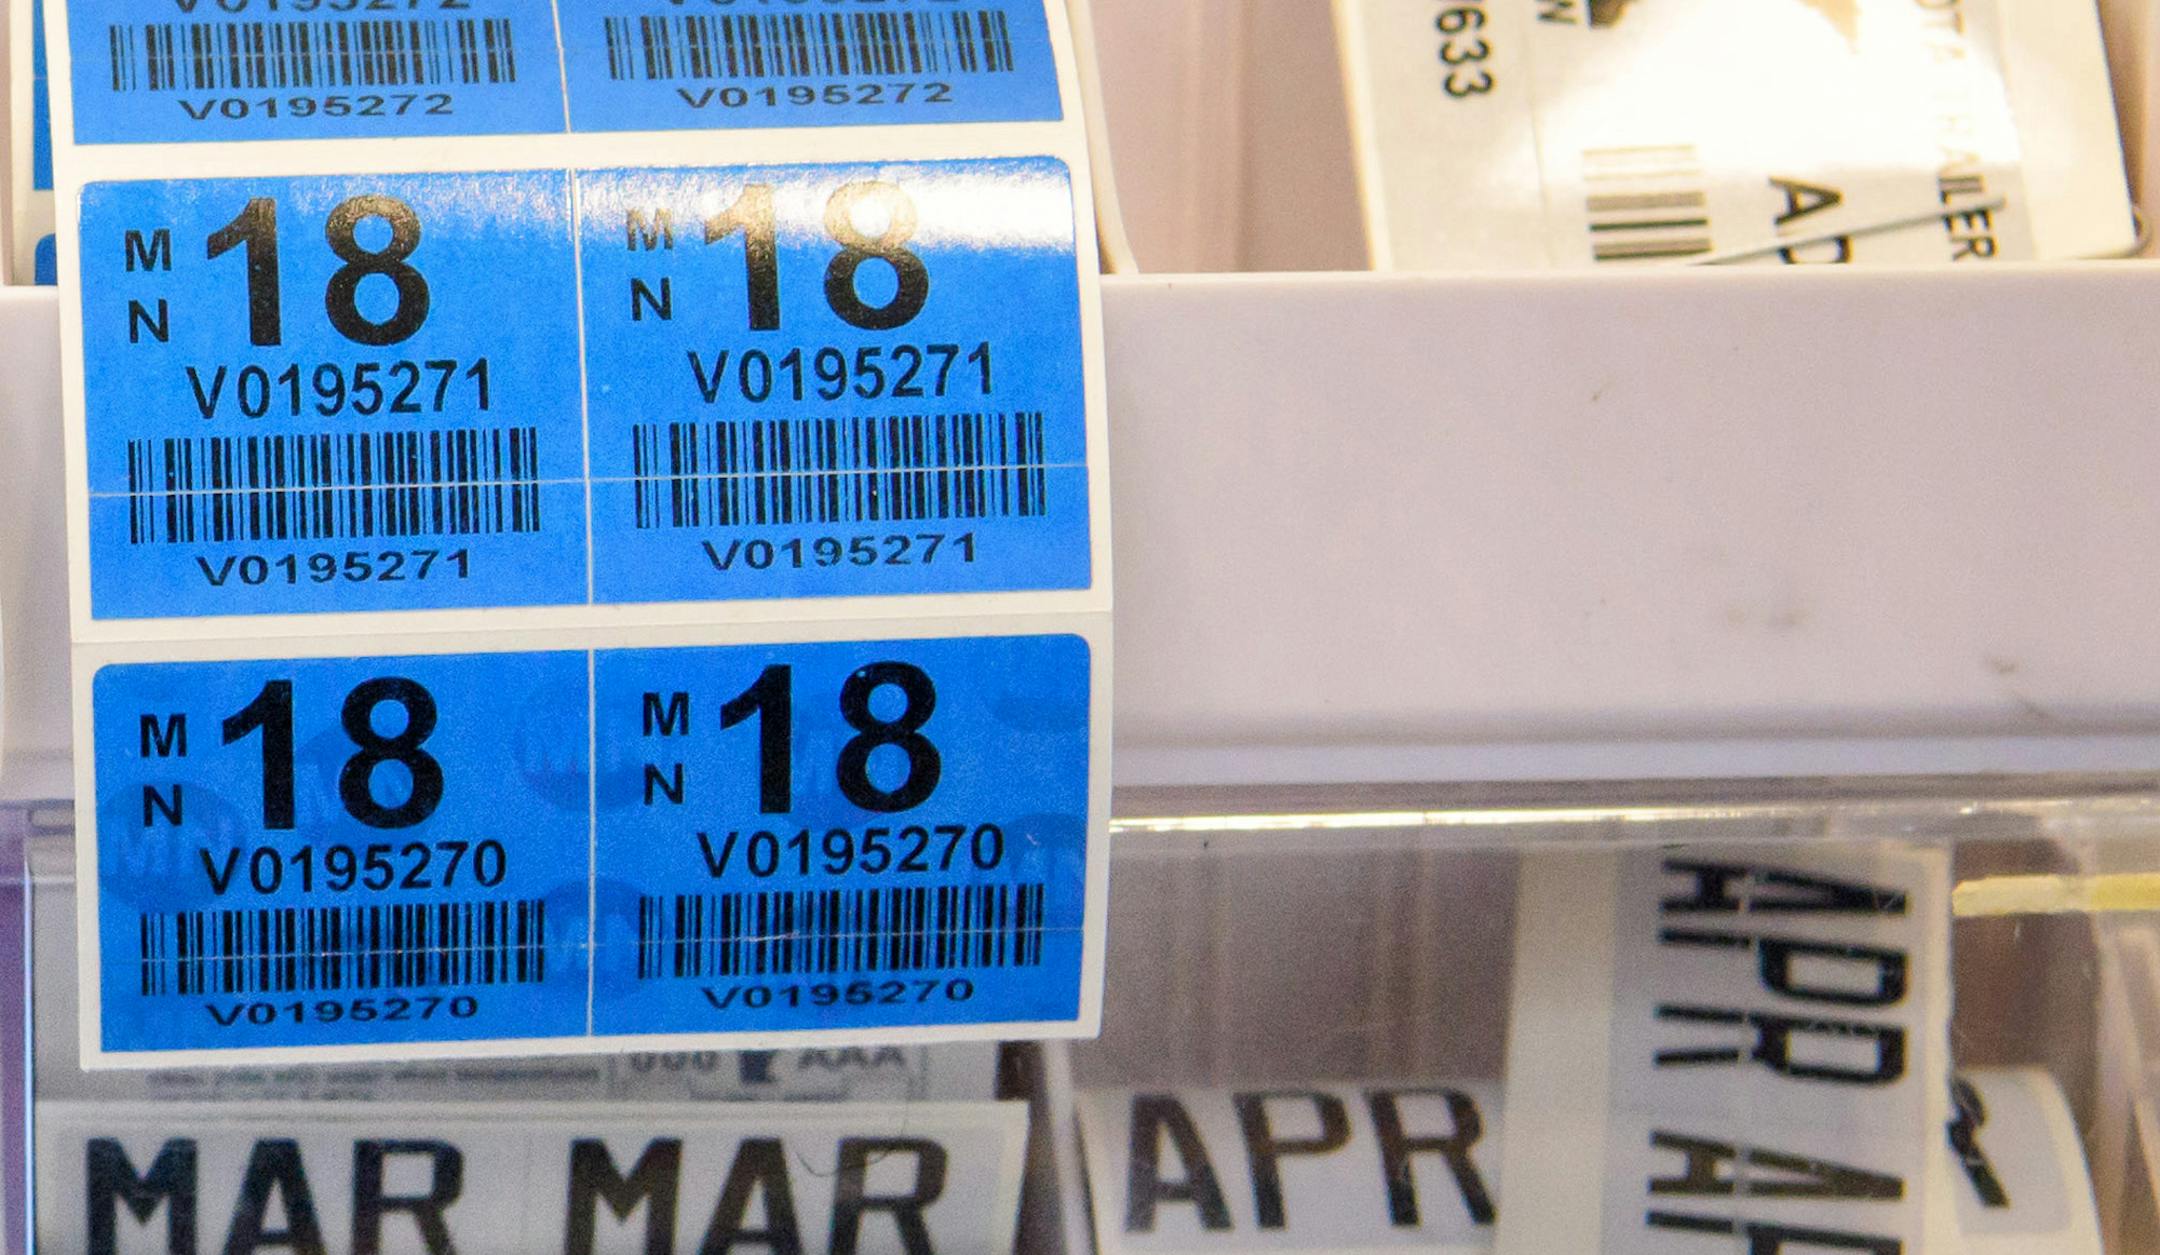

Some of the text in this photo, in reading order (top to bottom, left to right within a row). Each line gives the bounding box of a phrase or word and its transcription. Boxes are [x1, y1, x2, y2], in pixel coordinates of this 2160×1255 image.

[1436, 0, 1494, 99] 633
[178, 93, 453, 121] V0195272
[677, 81, 952, 109] V0195272
[125, 228, 172, 273] M
[626, 208, 674, 252] M
[207, 196, 431, 347] 18
[705, 181, 929, 331] 18
[129, 298, 170, 344] N
[631, 277, 672, 322] N
[186, 357, 490, 420] V0195271
[687, 341, 992, 404] V0195271
[196, 548, 469, 587] V0195271
[702, 531, 976, 571] V0195271
[140, 713, 188, 759] M
[643, 691, 690, 737] M
[222, 677, 444, 830] 18
[720, 661, 942, 815] 18
[143, 783, 183, 828] N
[644, 762, 684, 806] N
[199, 839, 507, 897] V0195270
[697, 822, 1006, 879] V0195270
[702, 978, 975, 1010] V0195270
[1654, 858, 1909, 1085] APR
[205, 995, 480, 1027] V0195270
[1123, 1087, 1498, 1232] APR
[85, 1137, 470, 1255] MAR
[564, 1137, 949, 1255] MAR
